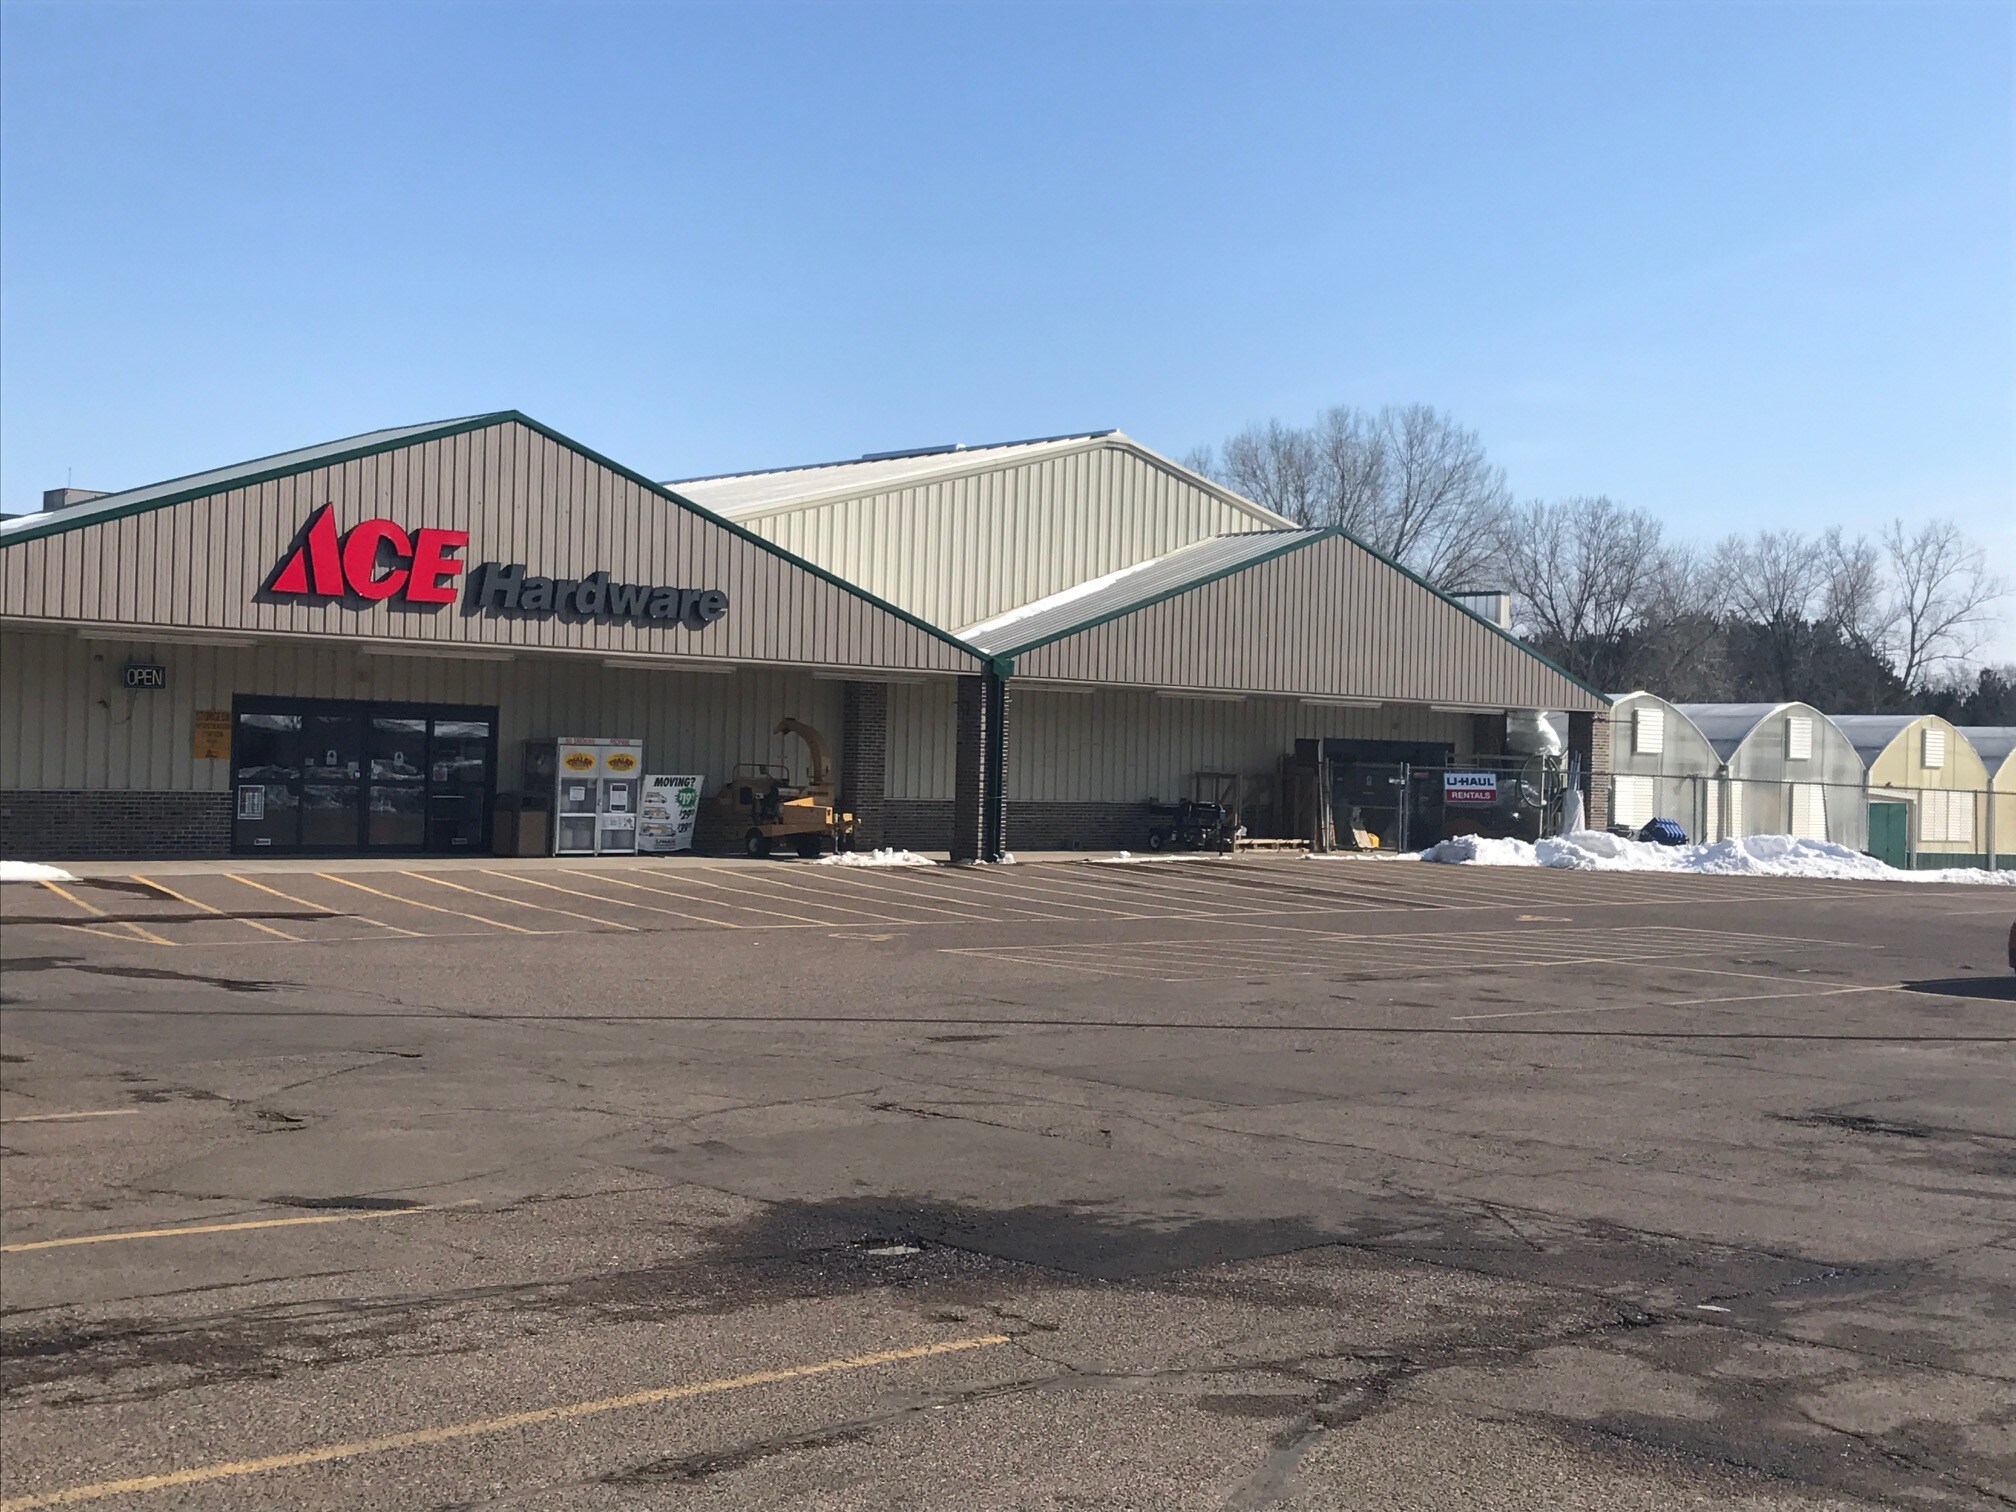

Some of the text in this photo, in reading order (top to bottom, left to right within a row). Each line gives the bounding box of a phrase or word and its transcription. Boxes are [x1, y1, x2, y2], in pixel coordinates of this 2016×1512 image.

[271, 501, 729, 622] ACE Hardware
[127, 668, 162, 686] OPEN
[653, 776, 697, 788] MOVING?
[1446, 776, 1495, 787] U-HAUL
[1451, 791, 1491, 800] RENTALS
